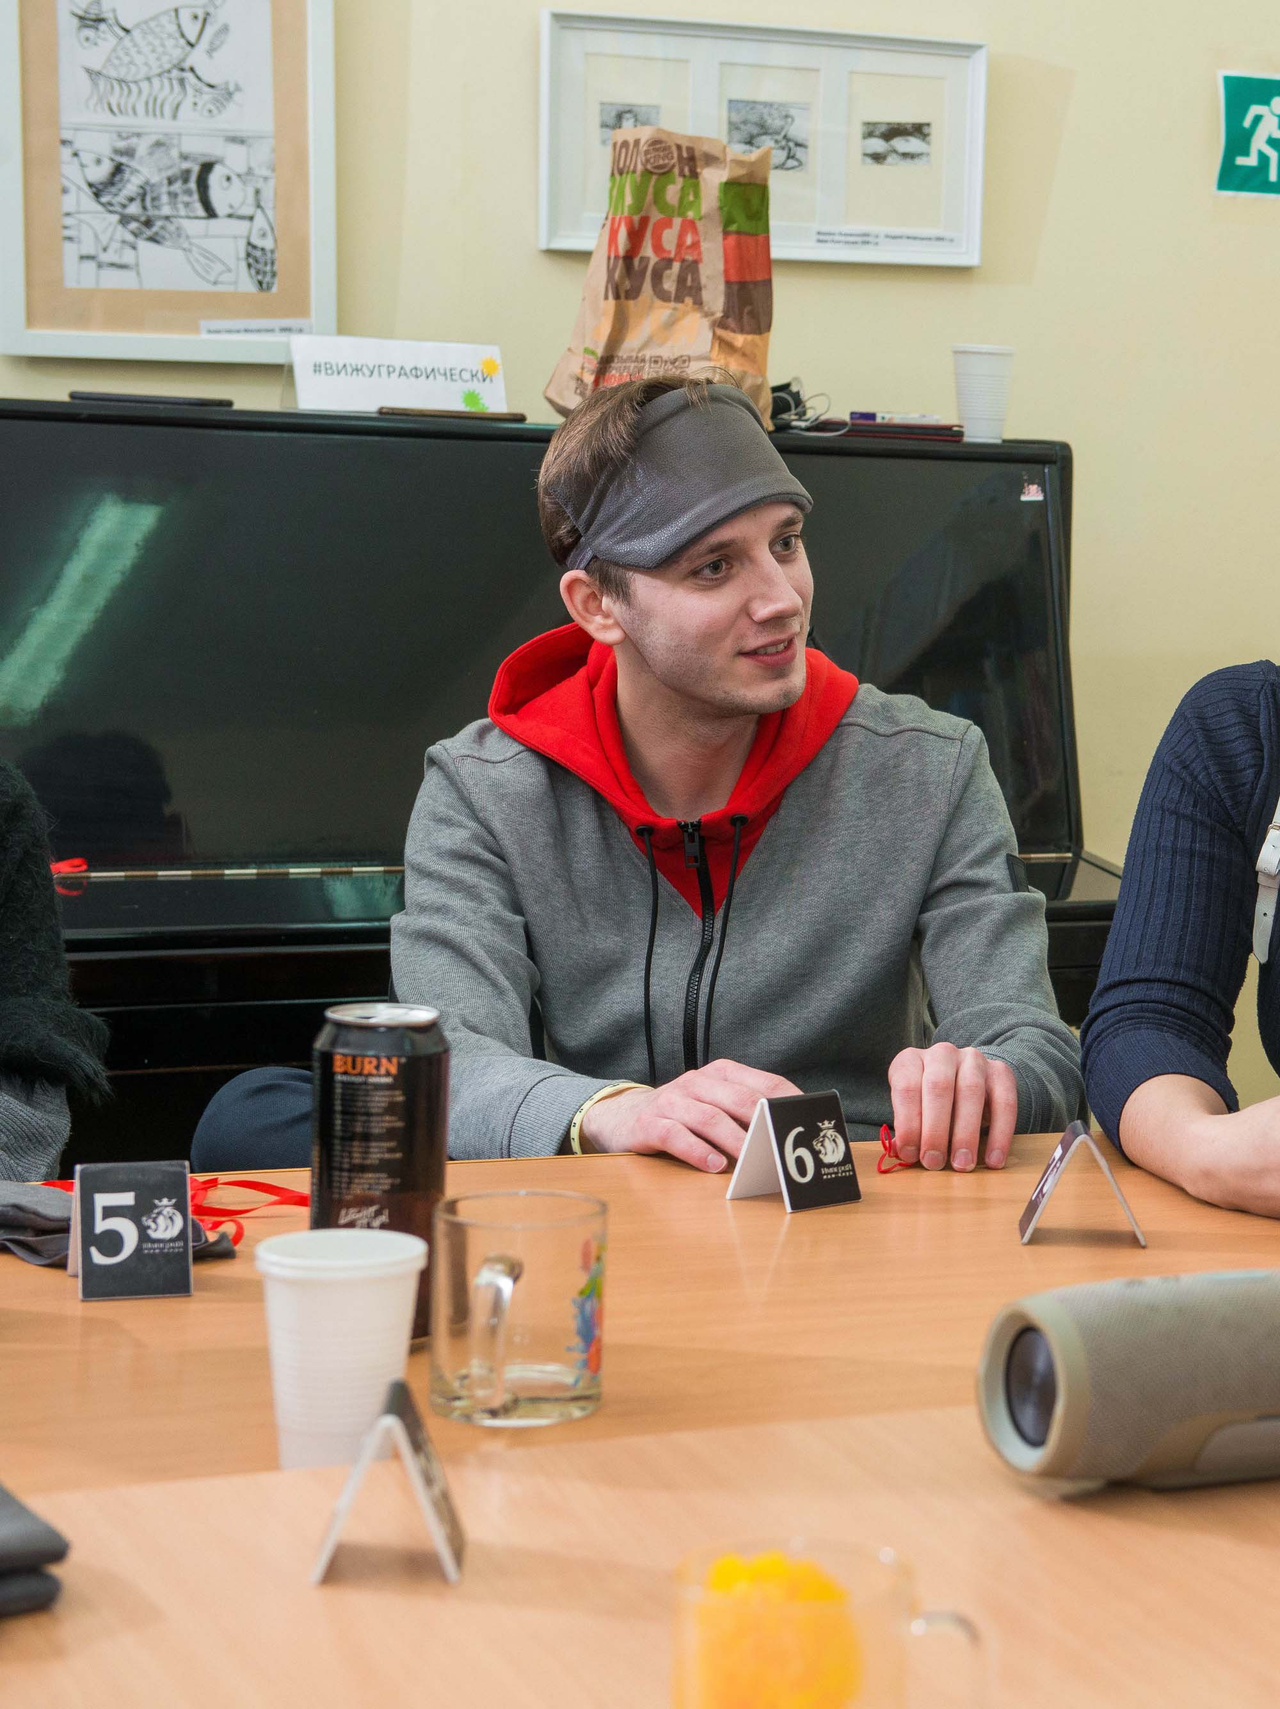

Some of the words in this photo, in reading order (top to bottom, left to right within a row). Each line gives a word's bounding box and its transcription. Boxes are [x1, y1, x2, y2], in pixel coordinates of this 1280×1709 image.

[313, 360, 494, 384] #ВИЖУГРАФИЧЕСКИ
[332, 1054, 398, 1076] BURN
[784, 1126, 815, 1184] 6
[89, 1191, 139, 1265] 5
